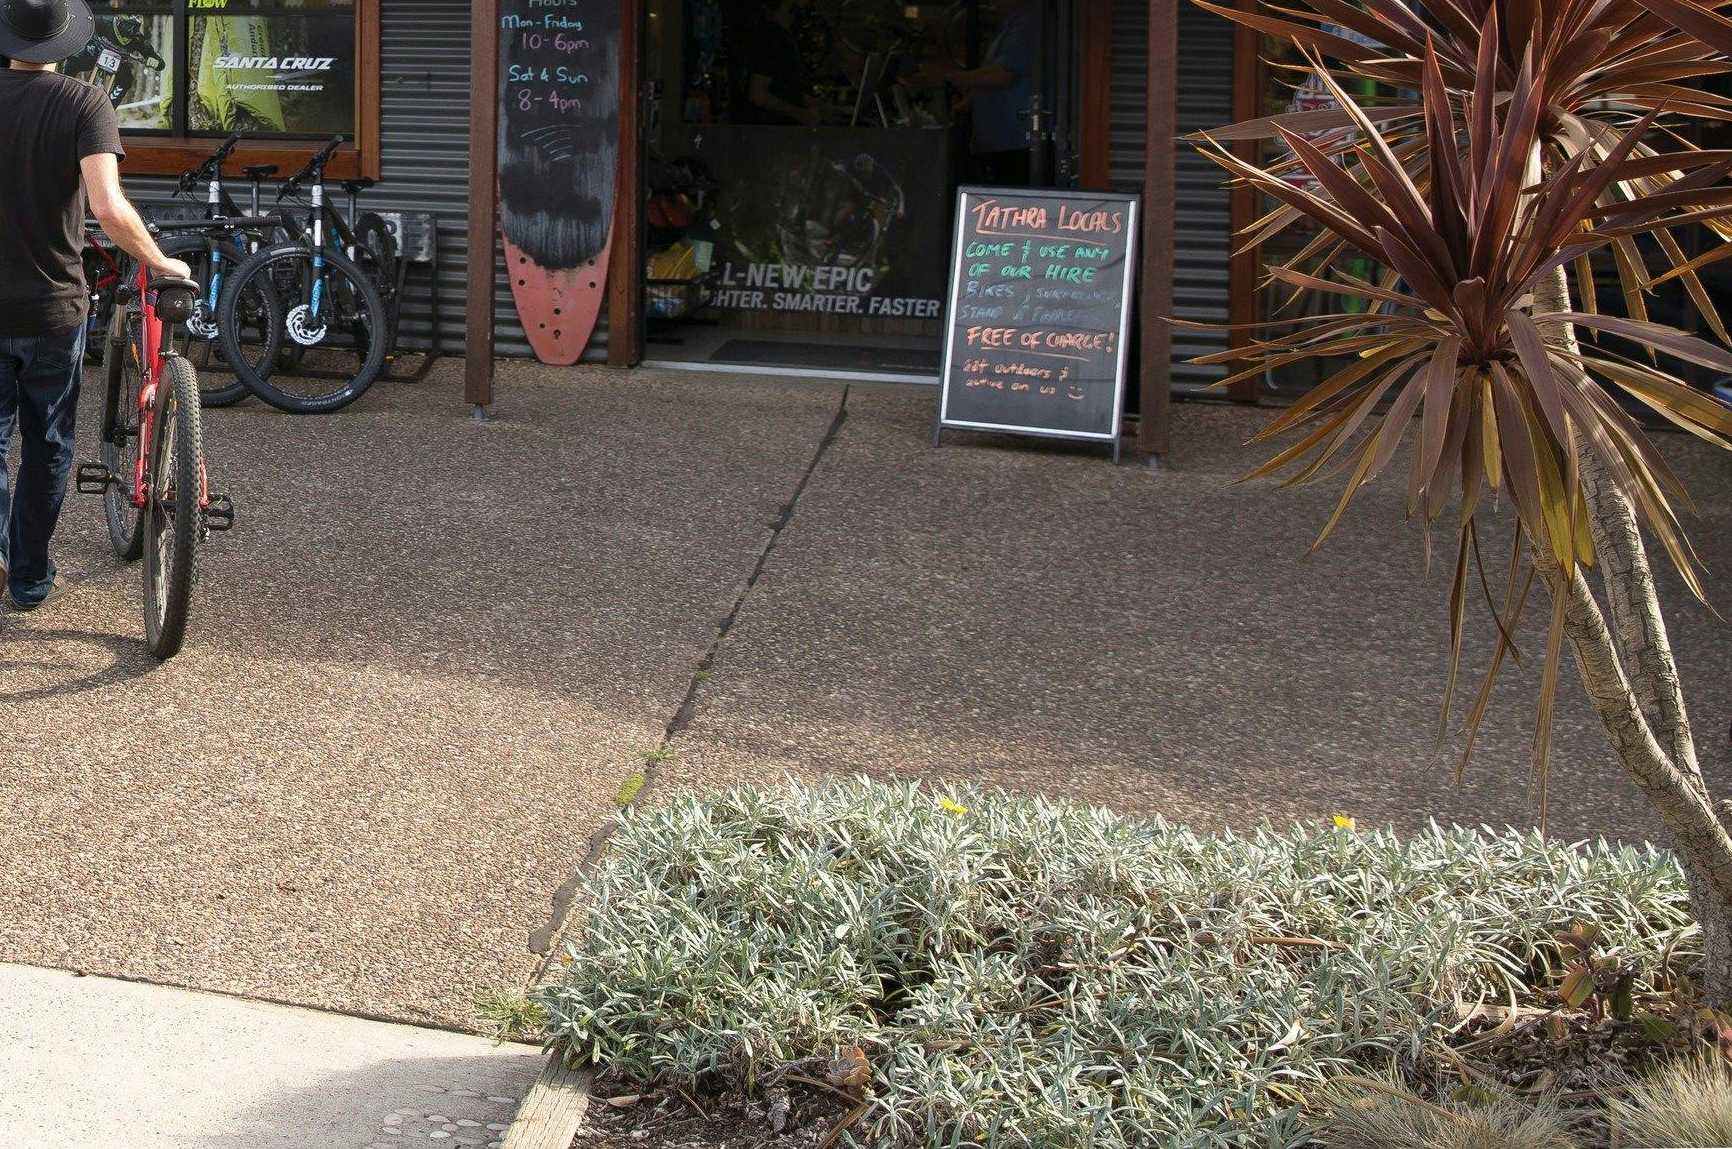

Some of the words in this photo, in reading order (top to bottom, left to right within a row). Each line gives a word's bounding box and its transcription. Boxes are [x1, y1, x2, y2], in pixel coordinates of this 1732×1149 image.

[103, 55, 116, 68] 13
[213, 57, 278, 70] SANTA
[279, 57, 334, 70] CRUZ
[508, 65, 534, 82] Sat
[556, 67, 588, 84] Sun
[225, 84, 286, 92] AUTHORISED
[287, 84, 324, 92] DEALER
[971, 200, 1048, 231] TATHRA
[1057, 204, 1122, 234] LOCALS
[965, 241, 1015, 258] COME
[1039, 243, 1069, 259] USE
[1074, 246, 1110, 261] ANY
[814, 265, 874, 292] EPIC
[968, 263, 991, 277] OF
[1000, 264, 1033, 280] OUR
[1045, 263, 1098, 285] HIRE
[773, 293, 863, 314] SMARTER.
[868, 296, 941, 318] FASTER
[966, 325, 1017, 347] FREE
[1020, 331, 1043, 349] OF
[1010, 382, 1029, 392] on
